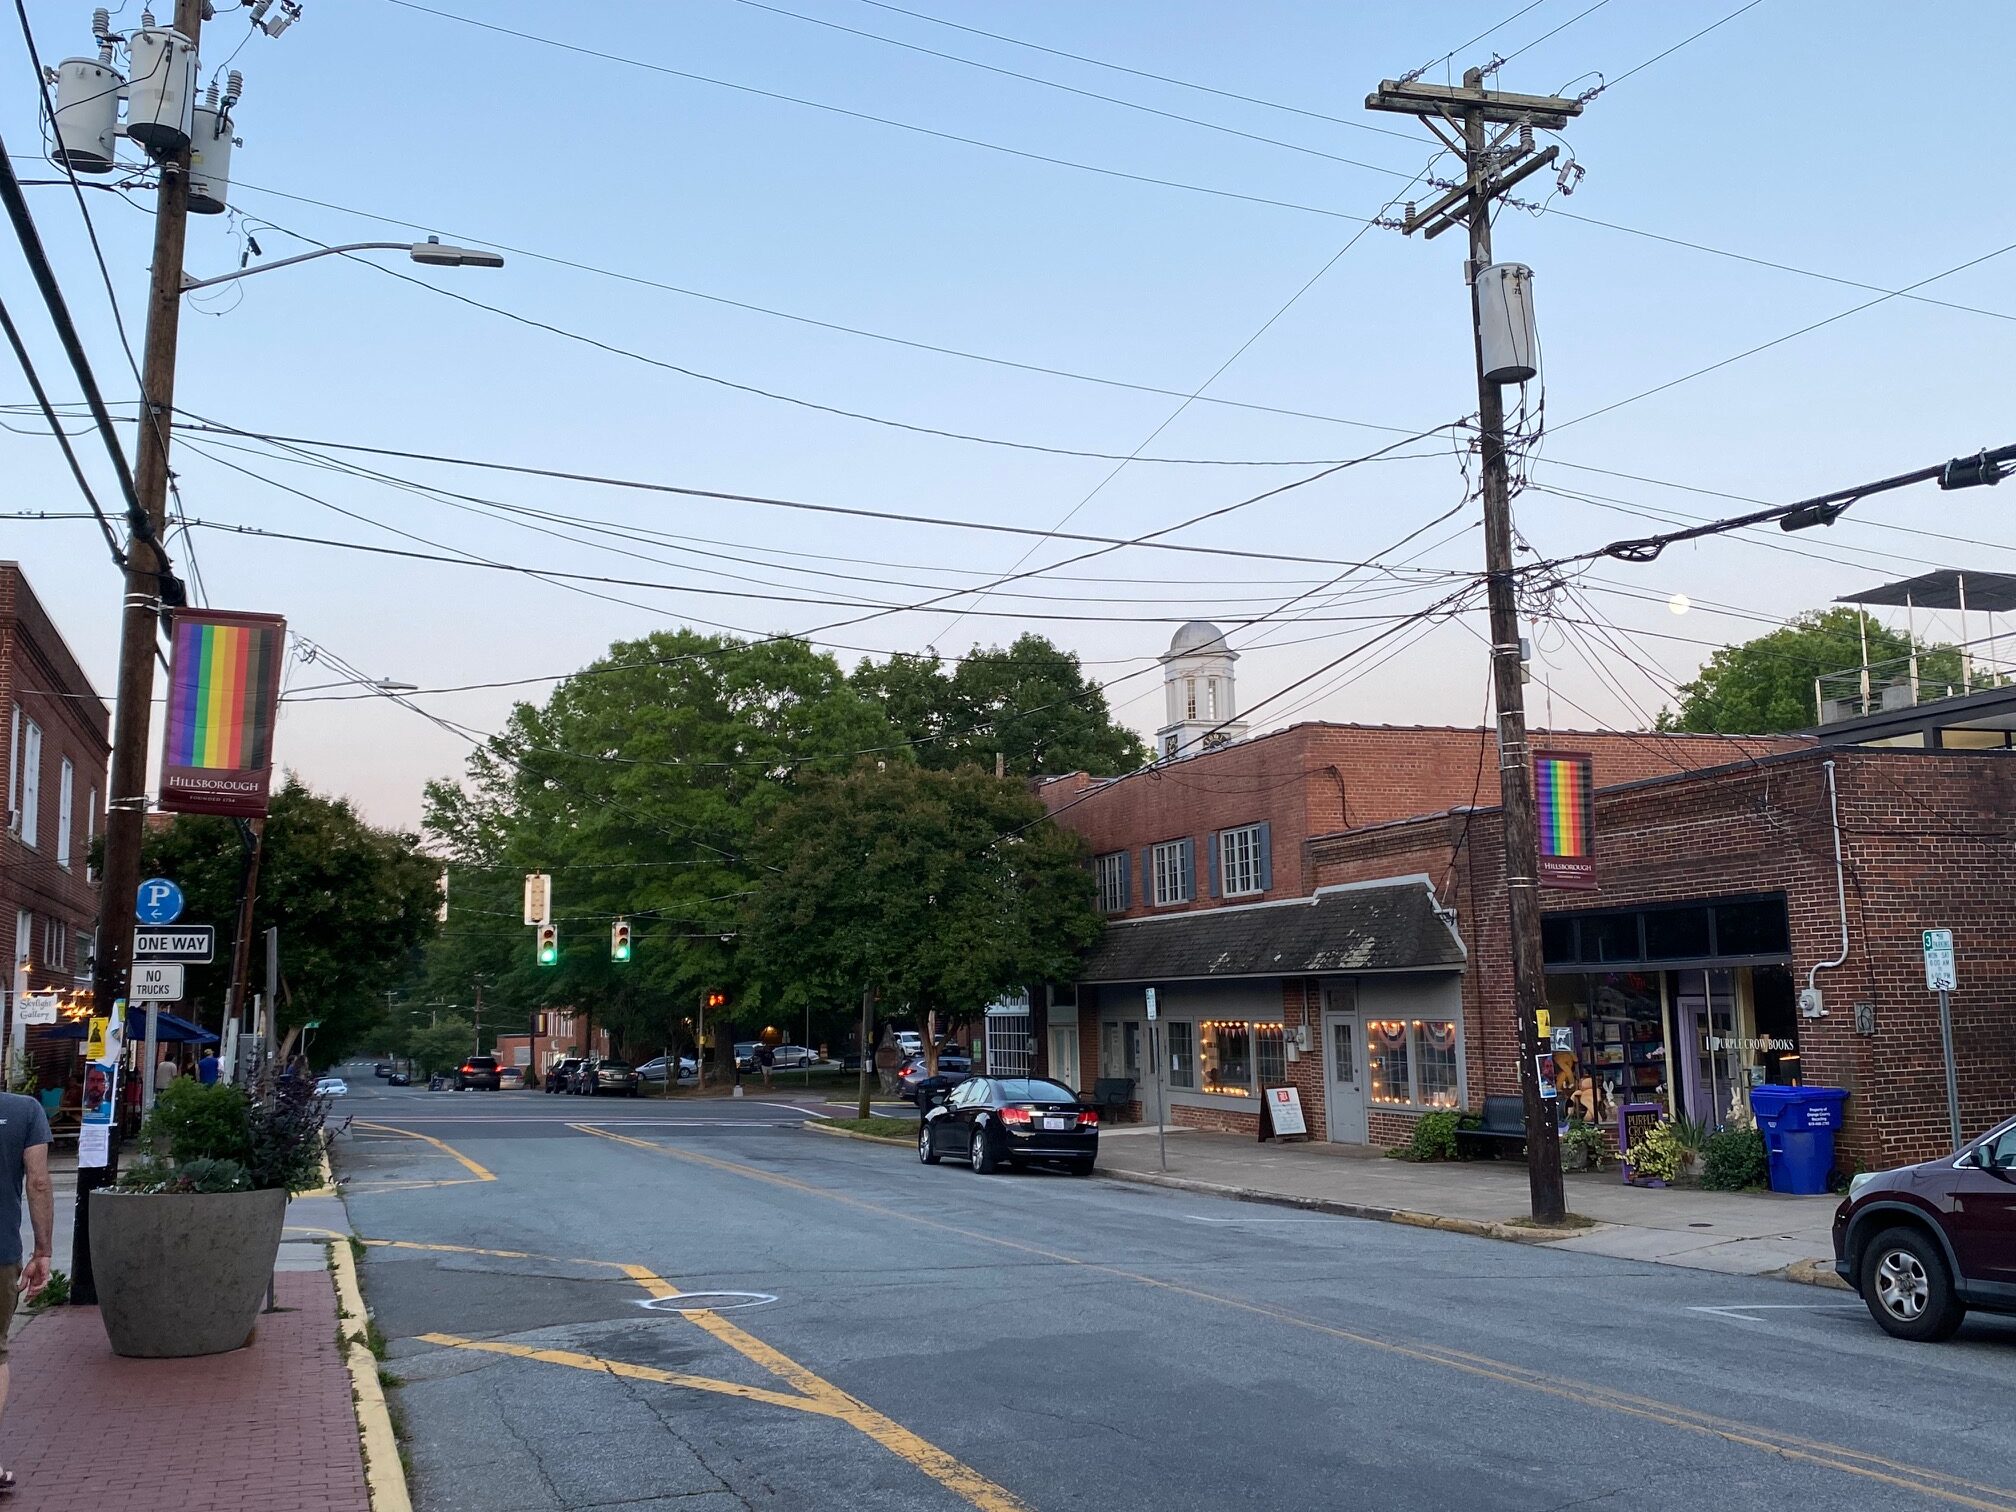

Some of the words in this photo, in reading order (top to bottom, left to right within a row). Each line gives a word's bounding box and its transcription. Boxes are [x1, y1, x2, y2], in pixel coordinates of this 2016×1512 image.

[169, 776, 259, 791] HILLSBOROUGH
[1544, 862, 1592, 871] HILLSBOROUGH
[147, 885, 170, 907] P
[137, 937, 168, 951] ONE
[172, 937, 206, 951] WAY
[1925, 936, 1931, 947] 3
[145, 970, 162, 982] NO
[136, 984, 170, 995] TRUCKS
[20, 1010, 50, 1020] Gallery
[1768, 1039, 1794, 1051] BOOKS
[1627, 1114, 1656, 1126] PURPLE
